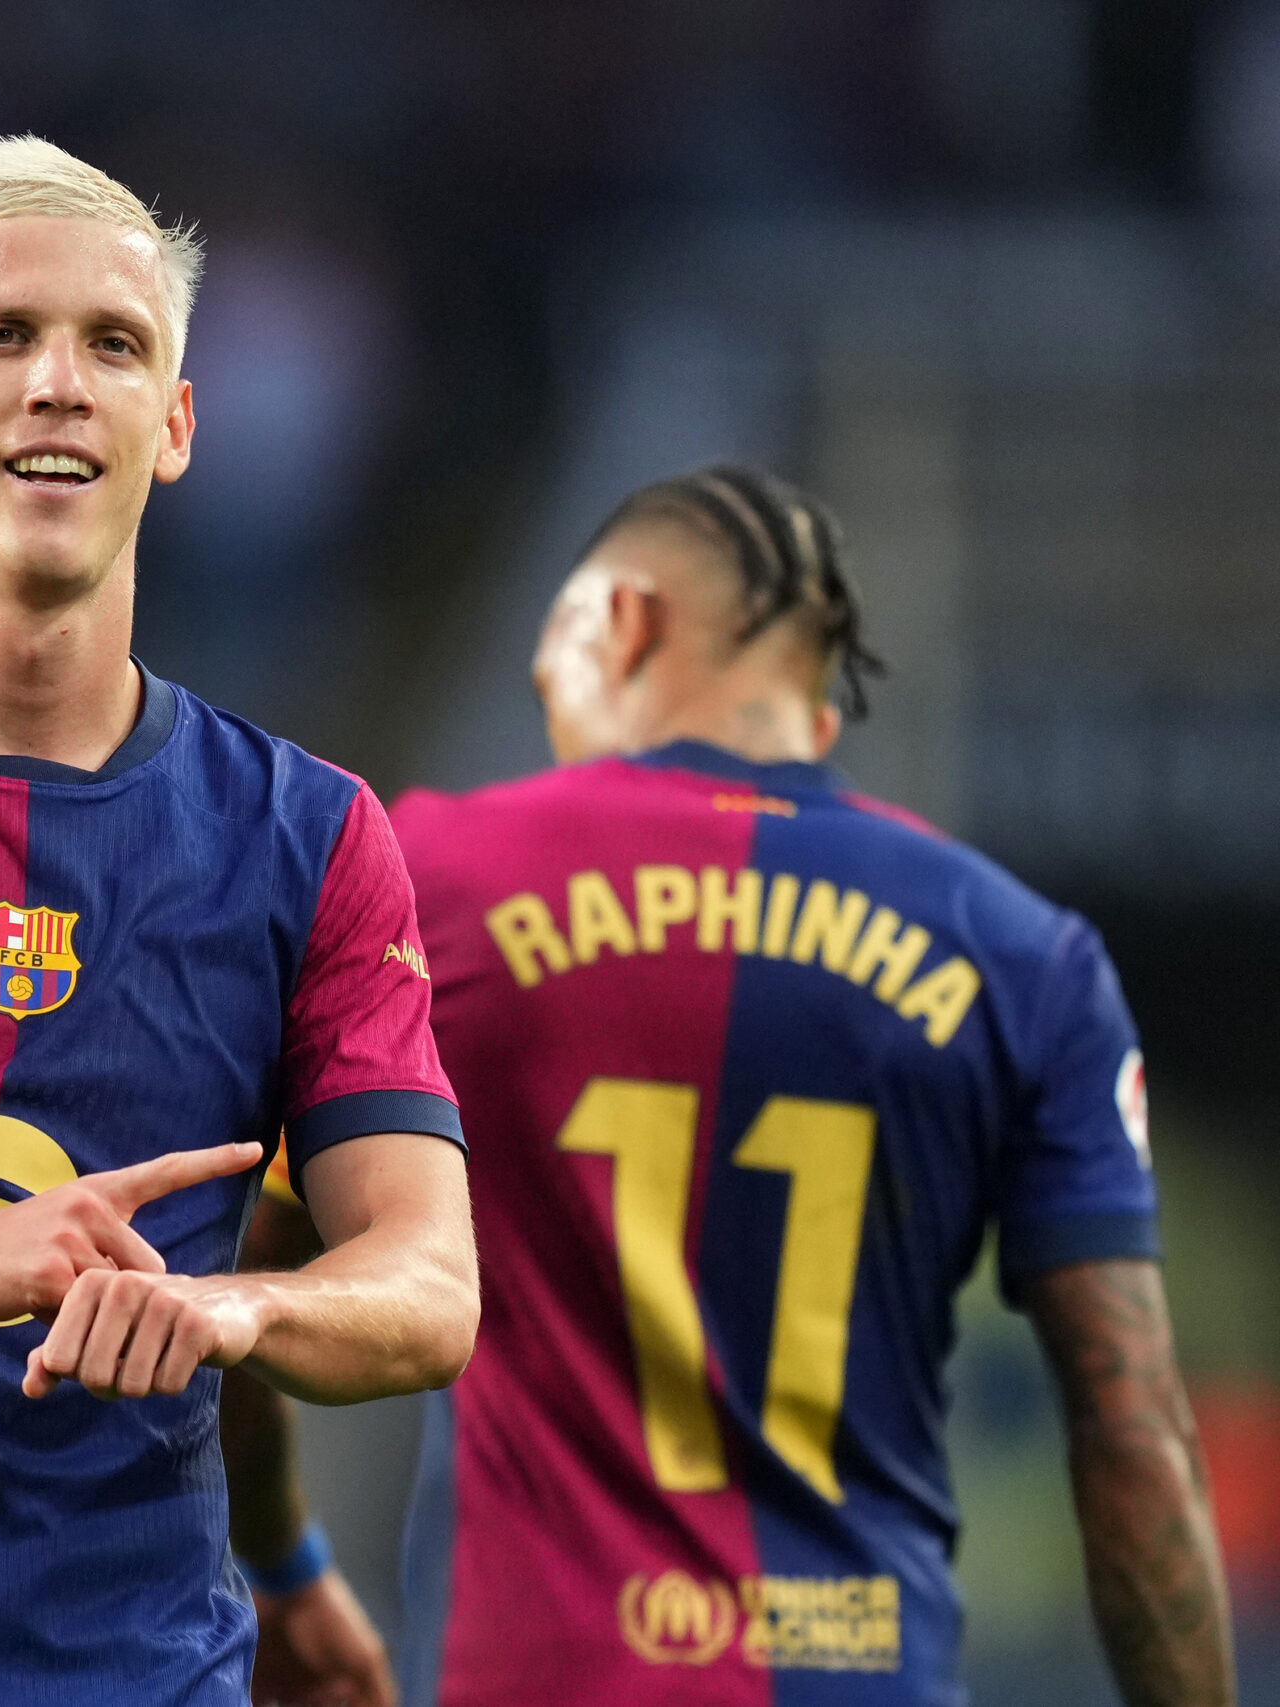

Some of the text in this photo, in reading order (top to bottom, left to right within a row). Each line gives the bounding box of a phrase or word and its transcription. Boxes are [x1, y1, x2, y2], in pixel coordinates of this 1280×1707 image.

[0, 949, 43, 967] FCB
[486, 865, 982, 1047] RAPHINHA
[556, 1075, 877, 1506] 11
